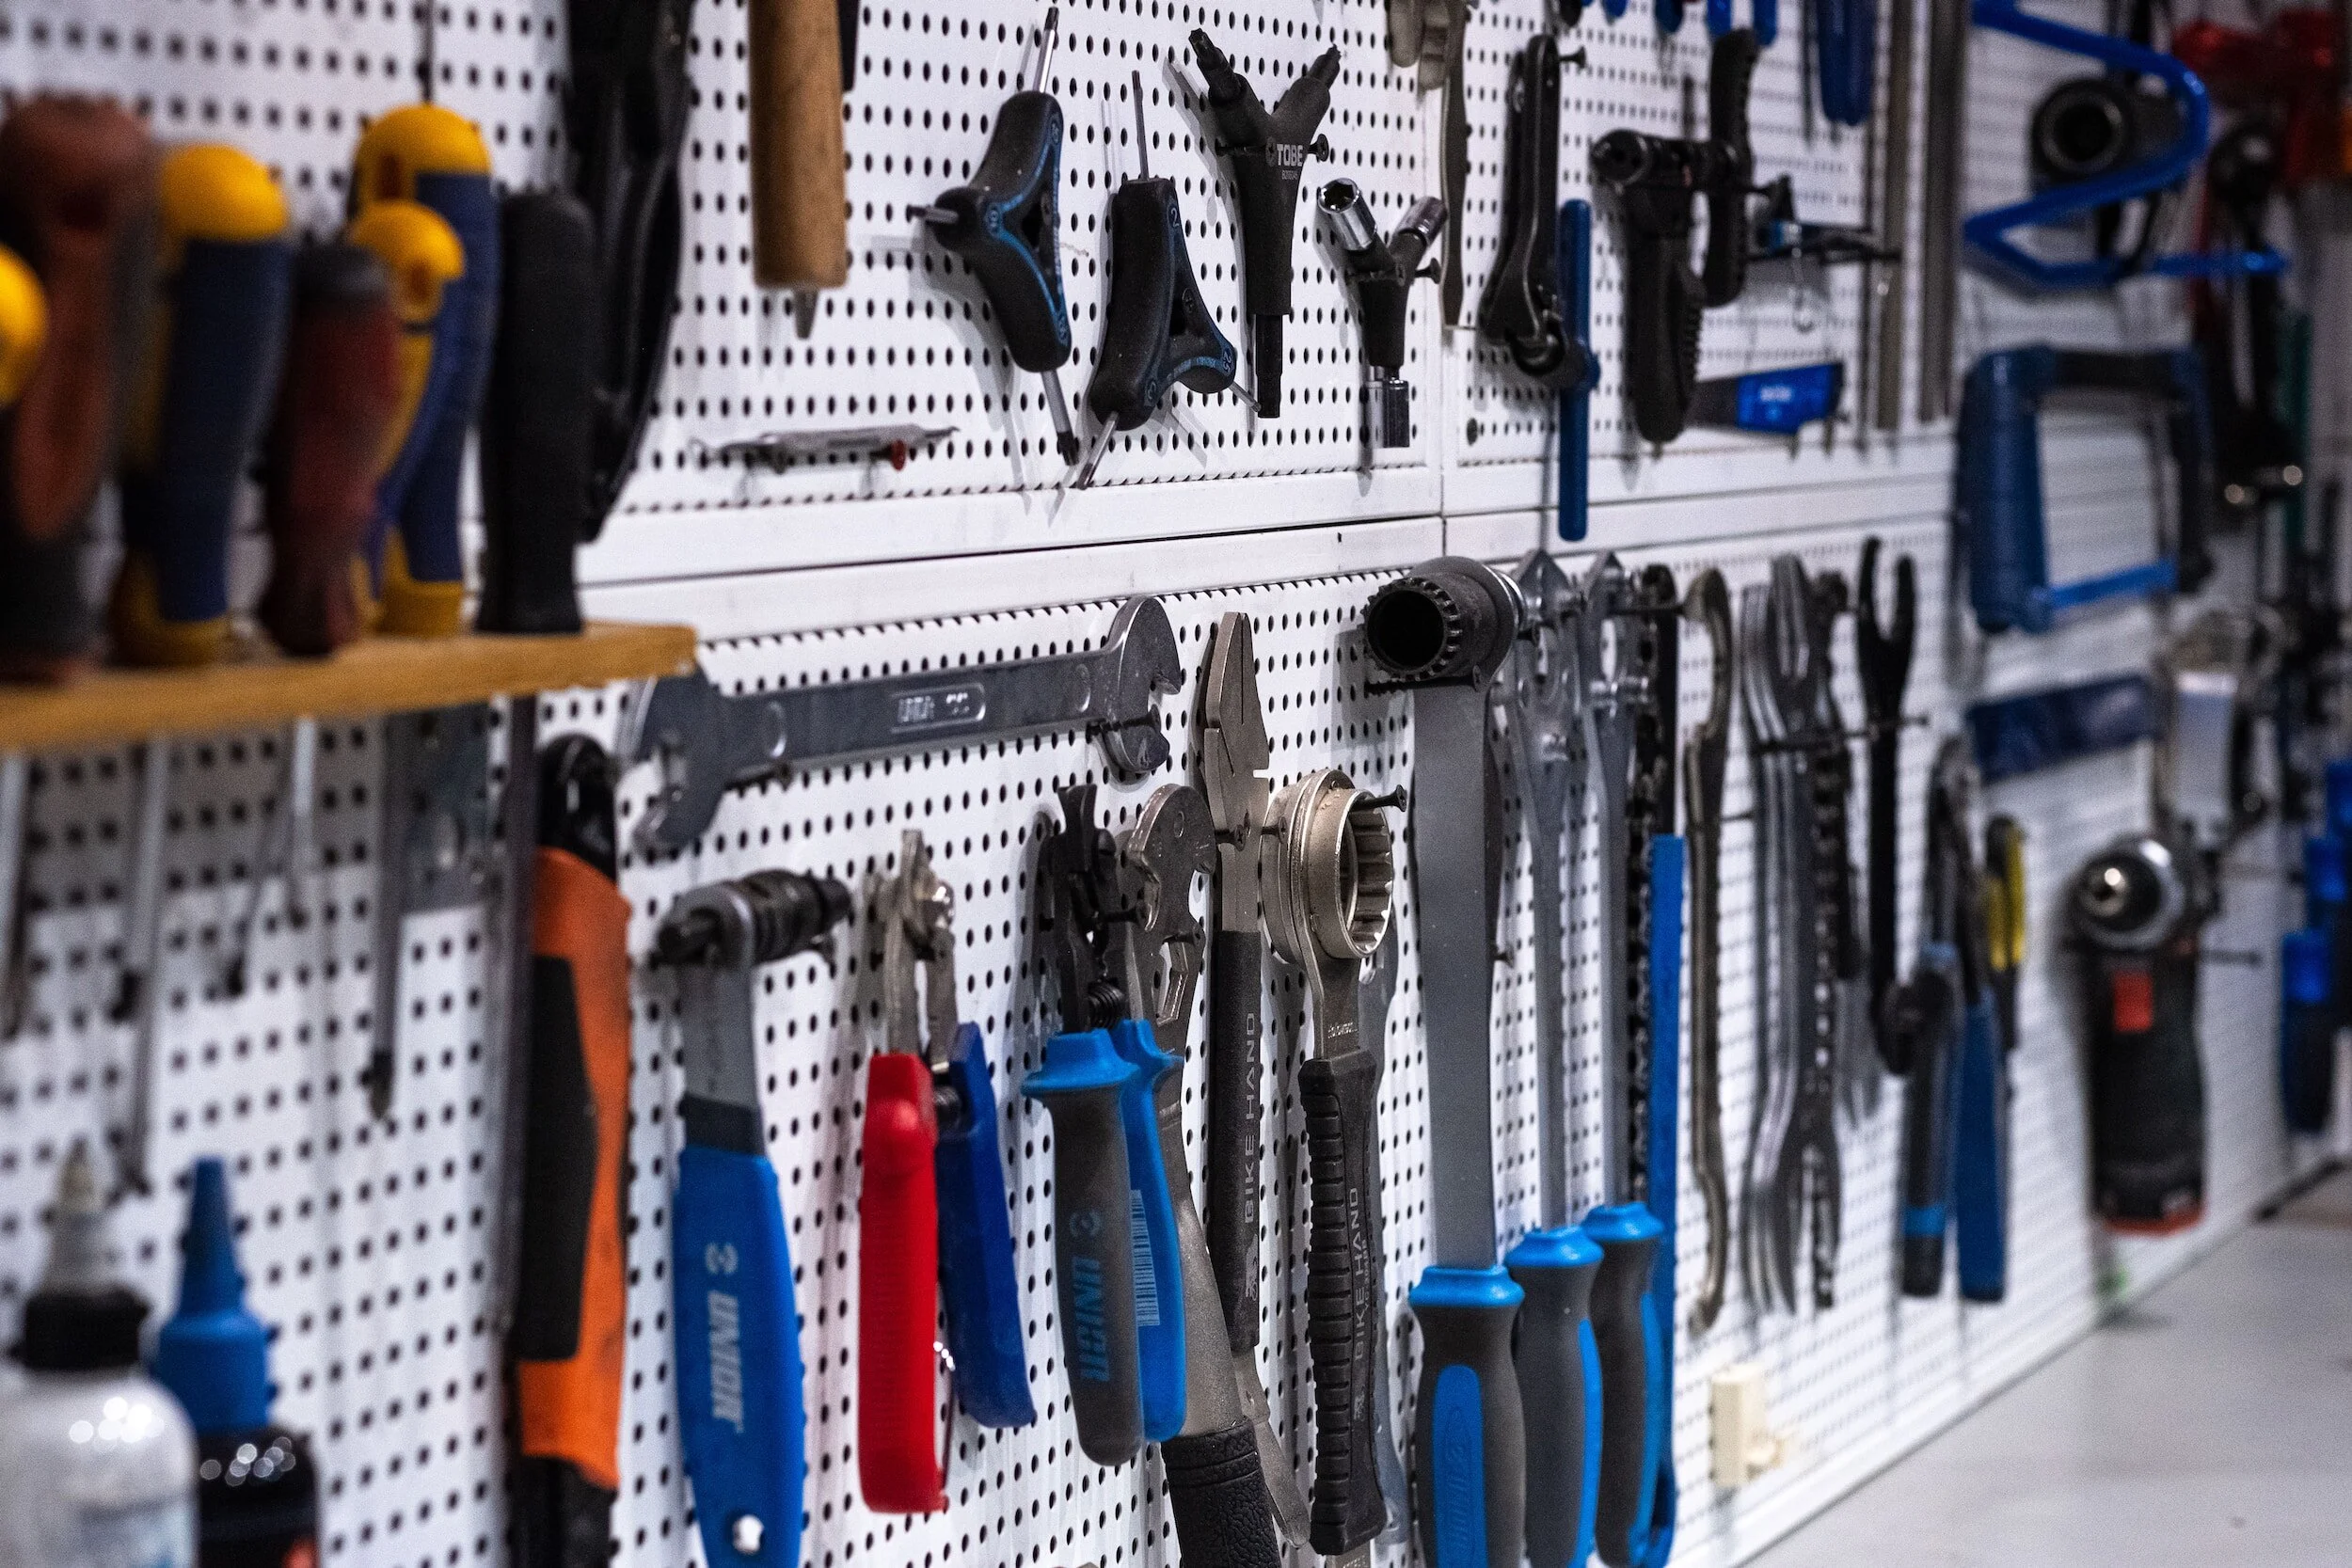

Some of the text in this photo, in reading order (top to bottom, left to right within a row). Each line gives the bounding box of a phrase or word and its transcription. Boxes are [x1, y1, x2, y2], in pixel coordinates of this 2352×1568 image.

[1277, 143, 1304, 166] TOBE
[1247, 1013, 1255, 1119] HAND
[1349, 1187, 1364, 1276] HAND
